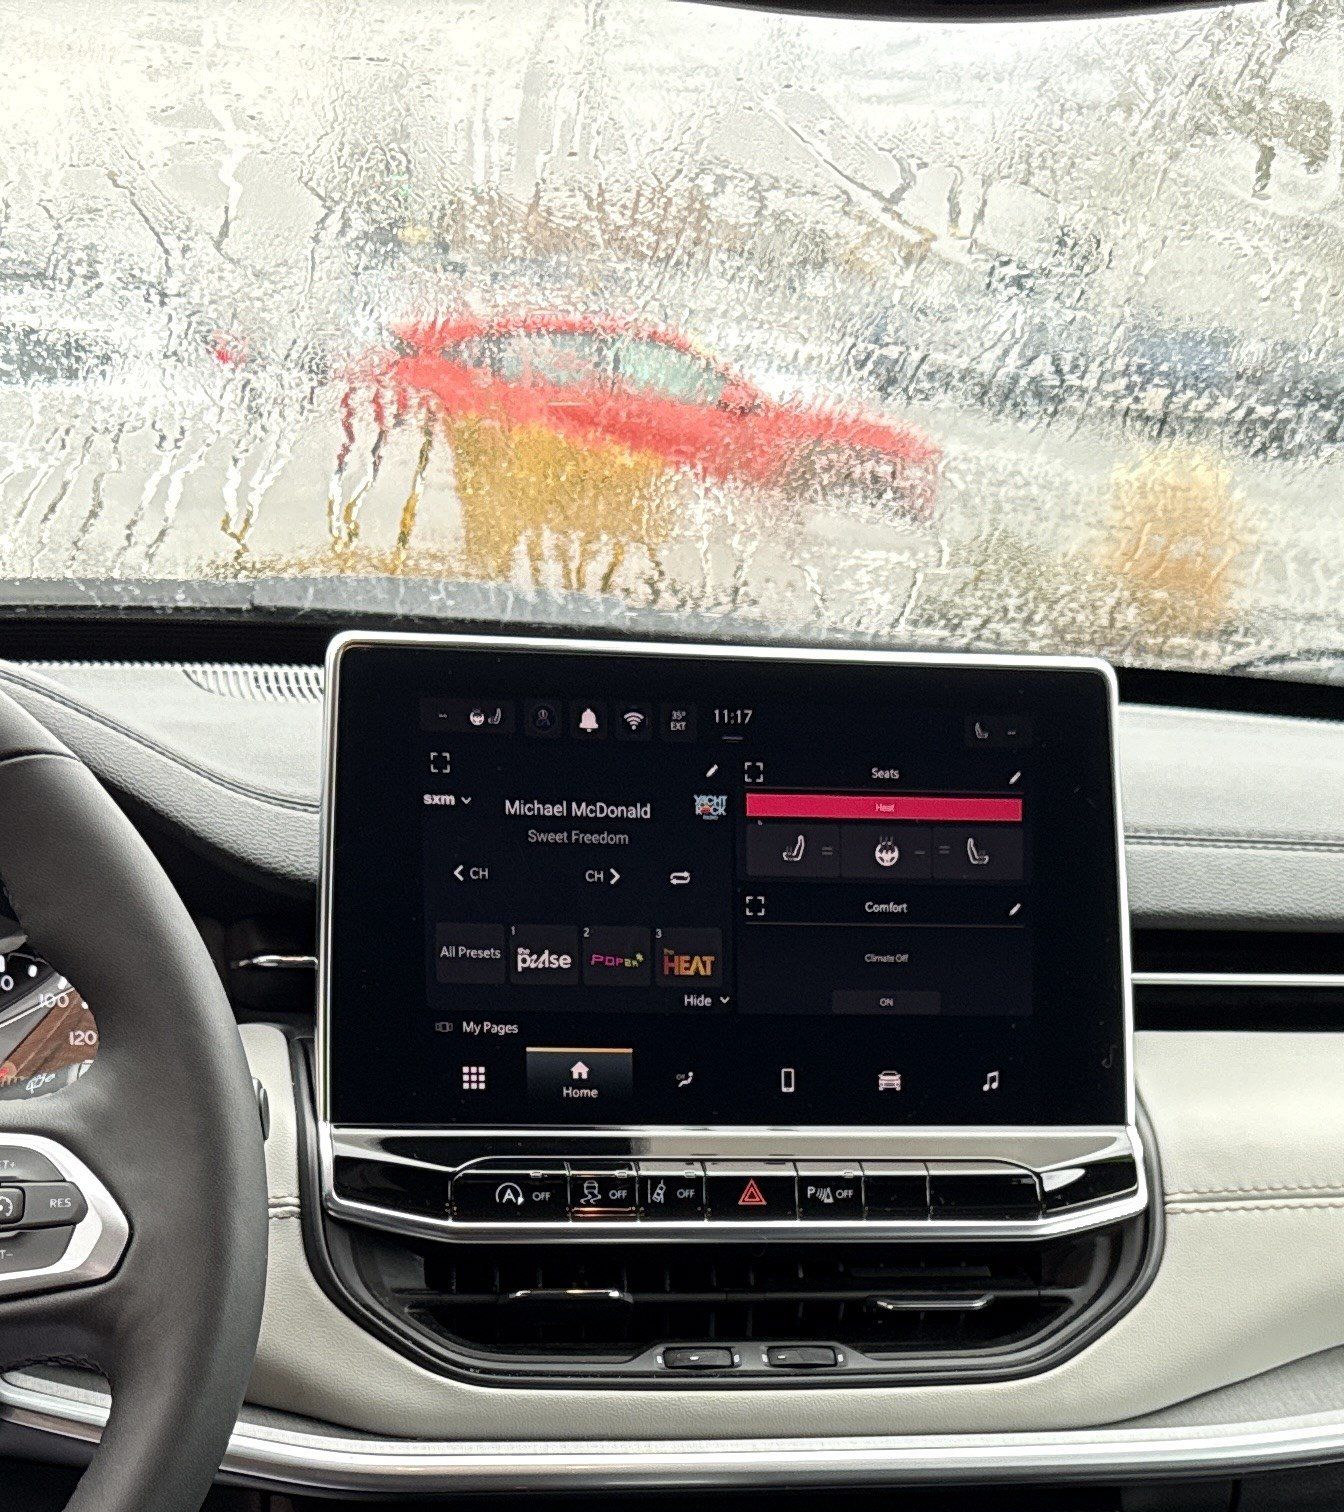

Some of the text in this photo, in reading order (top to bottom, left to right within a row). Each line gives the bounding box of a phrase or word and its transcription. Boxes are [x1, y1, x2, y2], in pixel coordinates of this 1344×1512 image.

[714, 709, 753, 724] 11:17
[670, 721, 687, 731] EXT
[871, 767, 900, 779] Seats
[423, 794, 455, 806] sxm
[505, 799, 651, 819] Michael McDonald
[528, 829, 629, 845] Sweet Freedom
[469, 868, 489, 880] CH
[585, 871, 604, 883] CH
[864, 901, 908, 913] Comfort
[582, 927, 590, 938] 2
[655, 928, 663, 939] 3
[439, 946, 501, 960] All Presets
[663, 955, 715, 976] HEAT
[37, 993, 69, 1008] 100
[683, 995, 712, 1007] Hide
[879, 998, 894, 1007] ON
[462, 1022, 519, 1036] My Pages
[69, 1030, 98, 1046] 120
[562, 1086, 599, 1099] Home
[532, 1191, 551, 1202] OFF
[609, 1189, 628, 1200] OFF
[676, 1188, 695, 1200] OFF
[835, 1188, 854, 1200] OFF
[49, 1198, 72, 1208] RES
